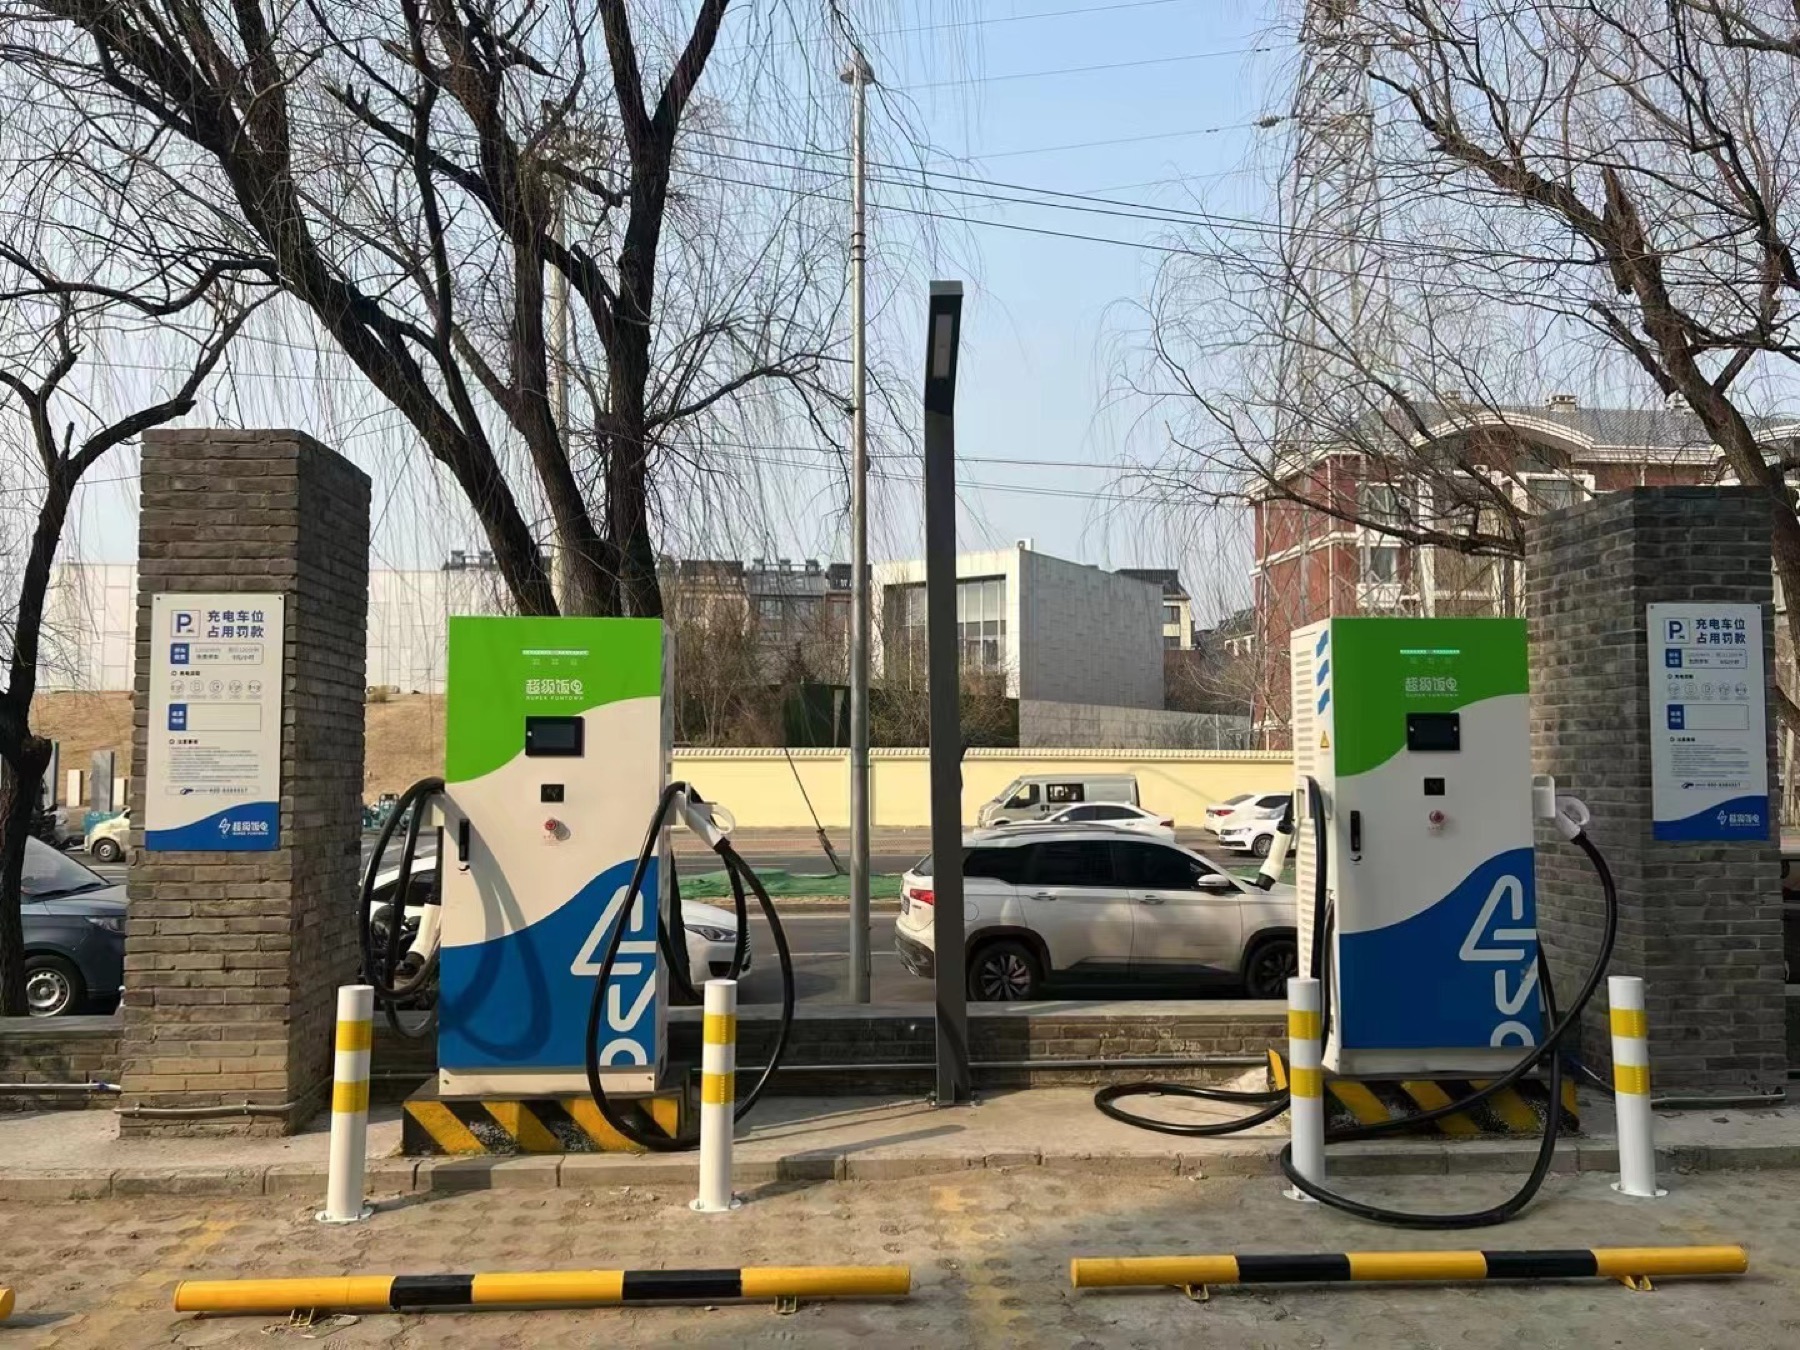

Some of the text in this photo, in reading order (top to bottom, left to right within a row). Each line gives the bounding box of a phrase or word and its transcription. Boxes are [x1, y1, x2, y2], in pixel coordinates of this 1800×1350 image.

[207, 609, 265, 623] 充电车位
[176, 613, 192, 633] P
[1669, 620, 1683, 639] P
[1695, 618, 1746, 630] 充电车位
[207, 625, 265, 638] 占用罚款
[1696, 632, 1746, 644] 占用罚款
